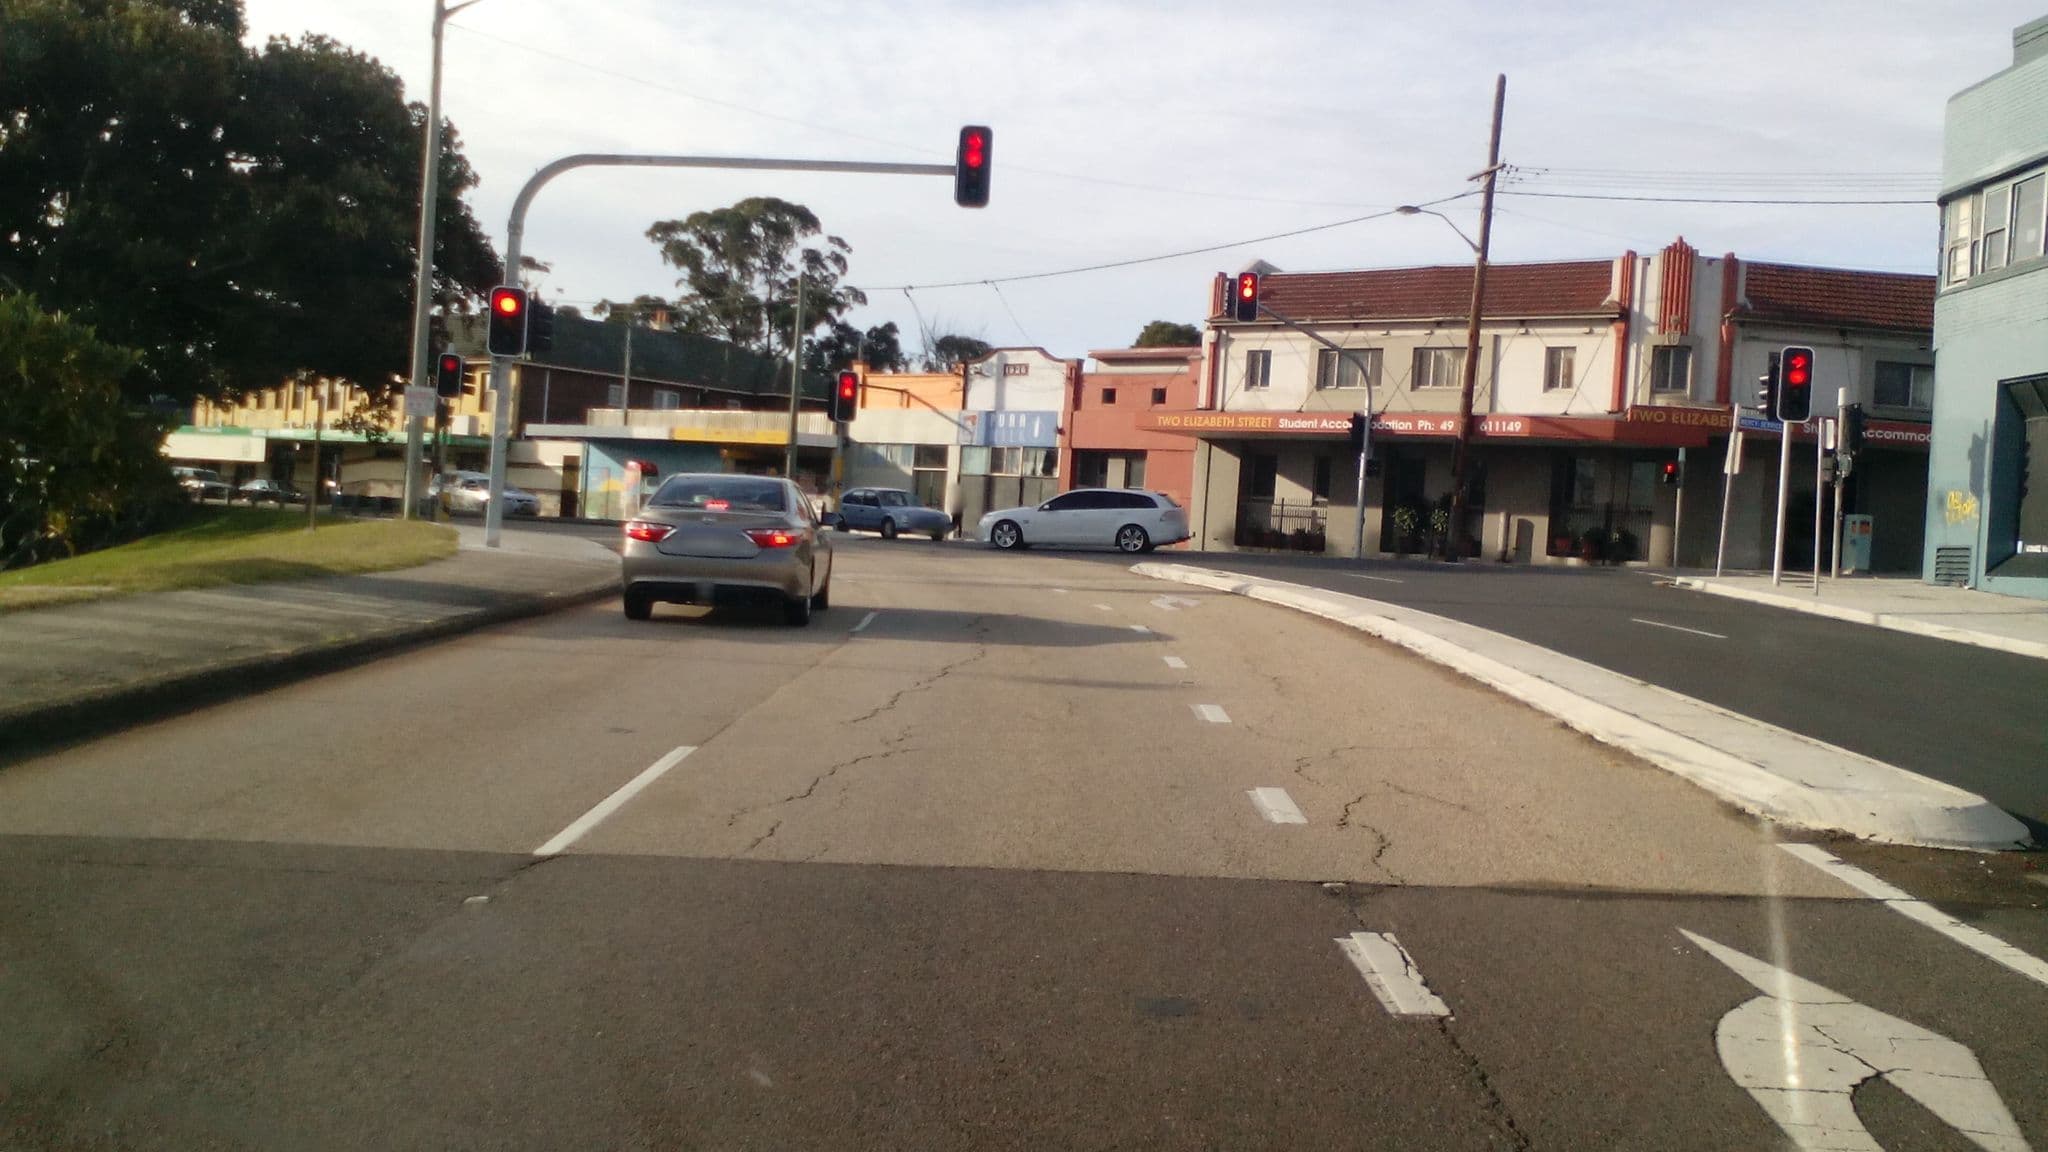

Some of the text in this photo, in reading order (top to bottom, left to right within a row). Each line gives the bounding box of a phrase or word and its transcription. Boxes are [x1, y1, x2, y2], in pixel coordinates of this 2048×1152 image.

[1157, 415, 1273, 429] TWO ELIZABETH STREET
[1632, 409, 1667, 423] TWO
[1278, 418, 1522, 432] Student Accoodation Ph: 49 611149
